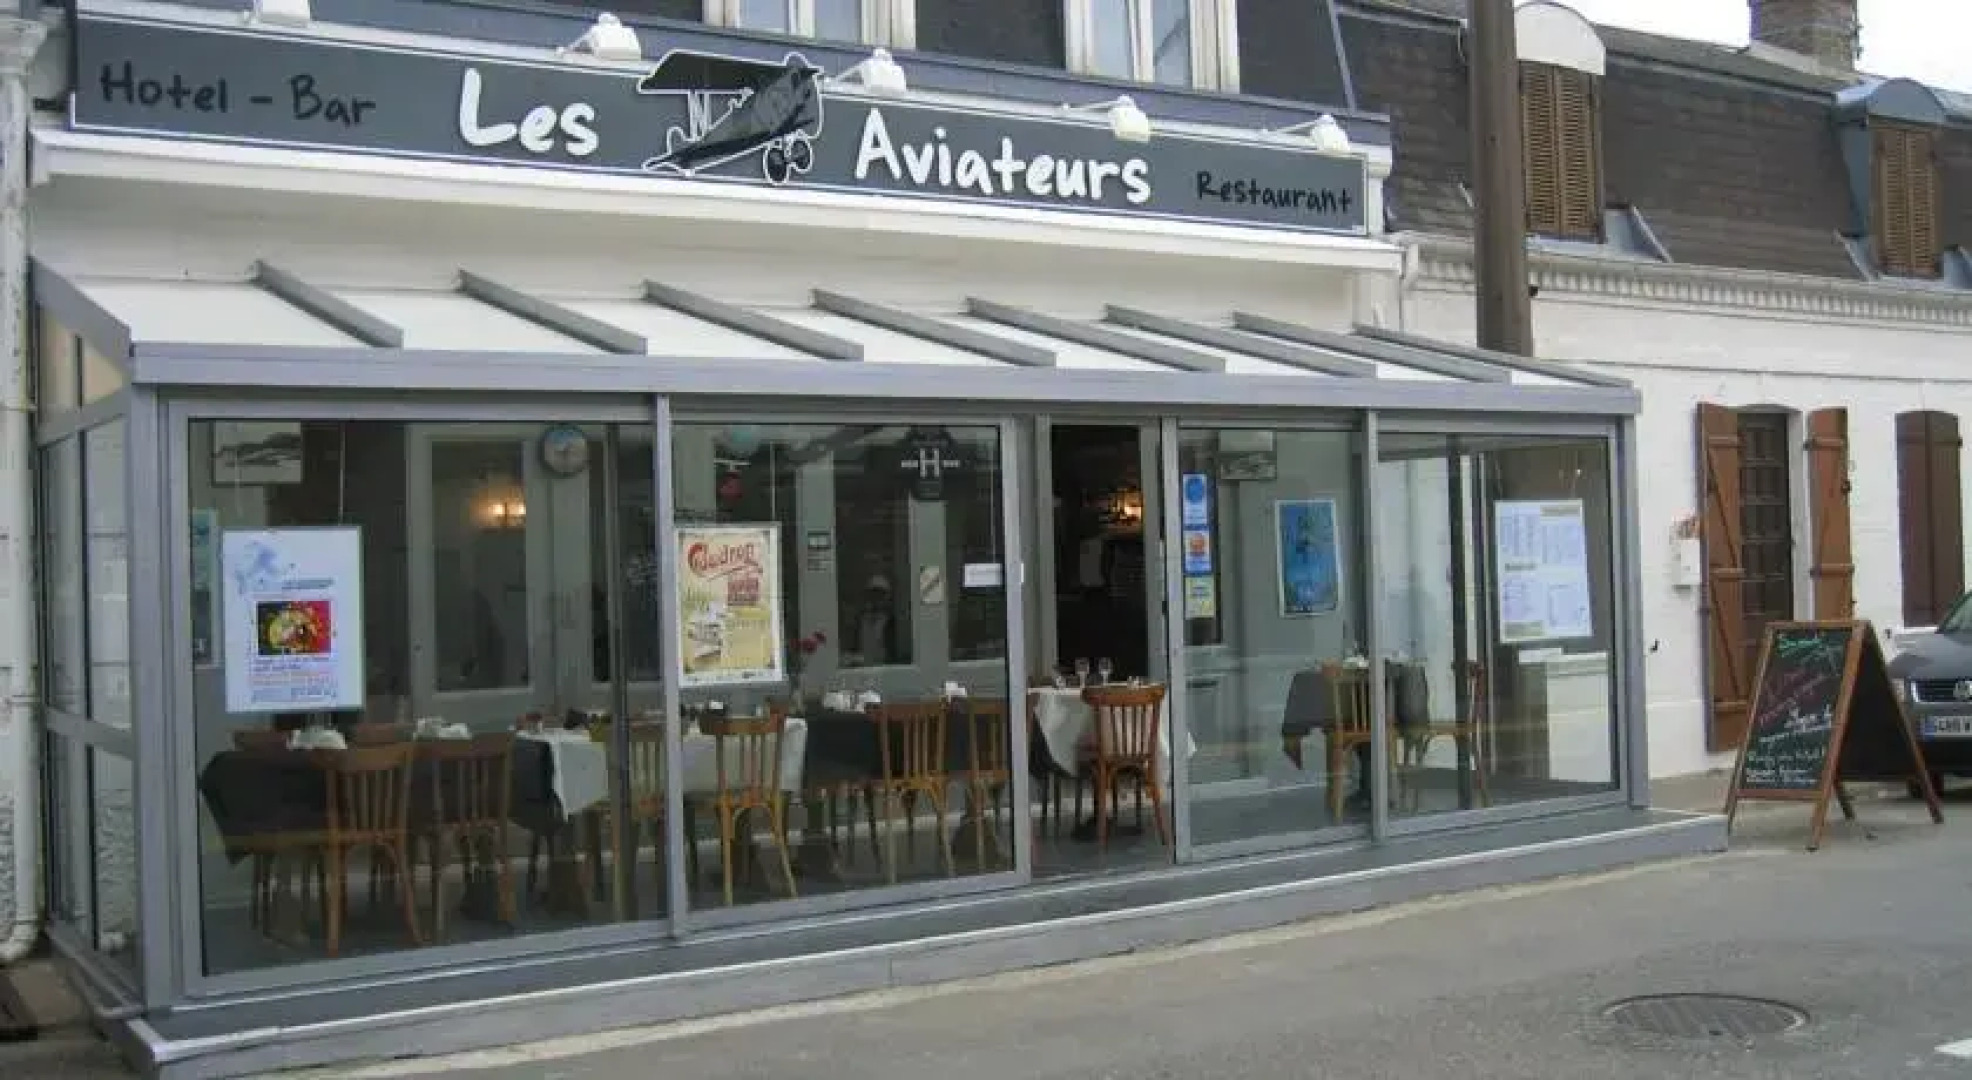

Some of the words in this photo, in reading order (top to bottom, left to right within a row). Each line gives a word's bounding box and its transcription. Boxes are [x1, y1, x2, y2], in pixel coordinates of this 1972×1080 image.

[100, 61, 228, 114] Hotel
[290, 73, 377, 128] Bar
[458, 67, 599, 156] Les
[855, 107, 1152, 205] Aviateurs
[1196, 170, 1353, 215] Restaurant
[919, 447, 940, 479] H
